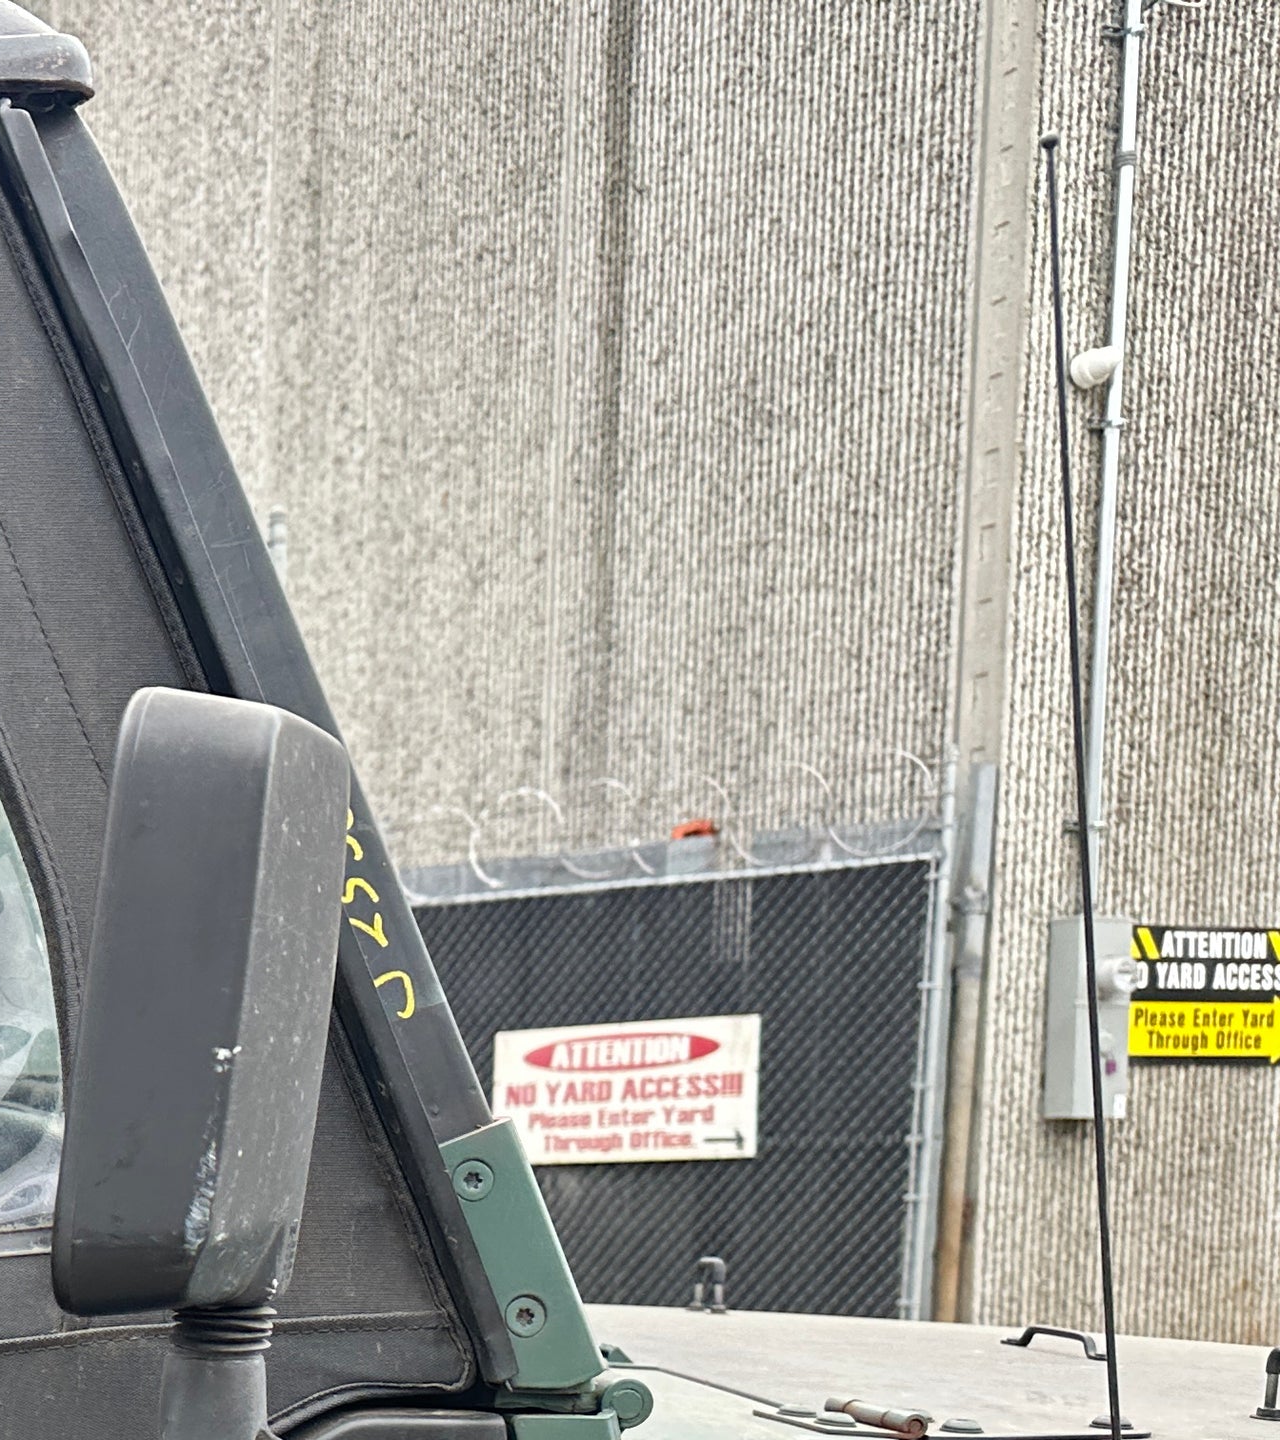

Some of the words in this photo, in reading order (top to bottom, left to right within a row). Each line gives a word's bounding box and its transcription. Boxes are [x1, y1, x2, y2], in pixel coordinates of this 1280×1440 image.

[1161, 930, 1267, 959] ATTENTION
[1156, 962, 1206, 990] YARD
[1134, 1007, 1185, 1027] Please
[1193, 1008, 1234, 1027] Enter
[1242, 1010, 1275, 1028] Yard
[550, 1035, 690, 1069] ATTENTION
[1148, 1030, 1208, 1054] Through
[1216, 1032, 1262, 1049] Office
[506, 1084, 536, 1107] NO
[546, 1079, 612, 1104] YARD
[622, 1073, 744, 1100] ACCESS!!!
[529, 1112, 591, 1130] Please
[598, 1108, 655, 1127] Enter
[662, 1105, 715, 1124] Yard
[544, 1134, 623, 1152] Through
